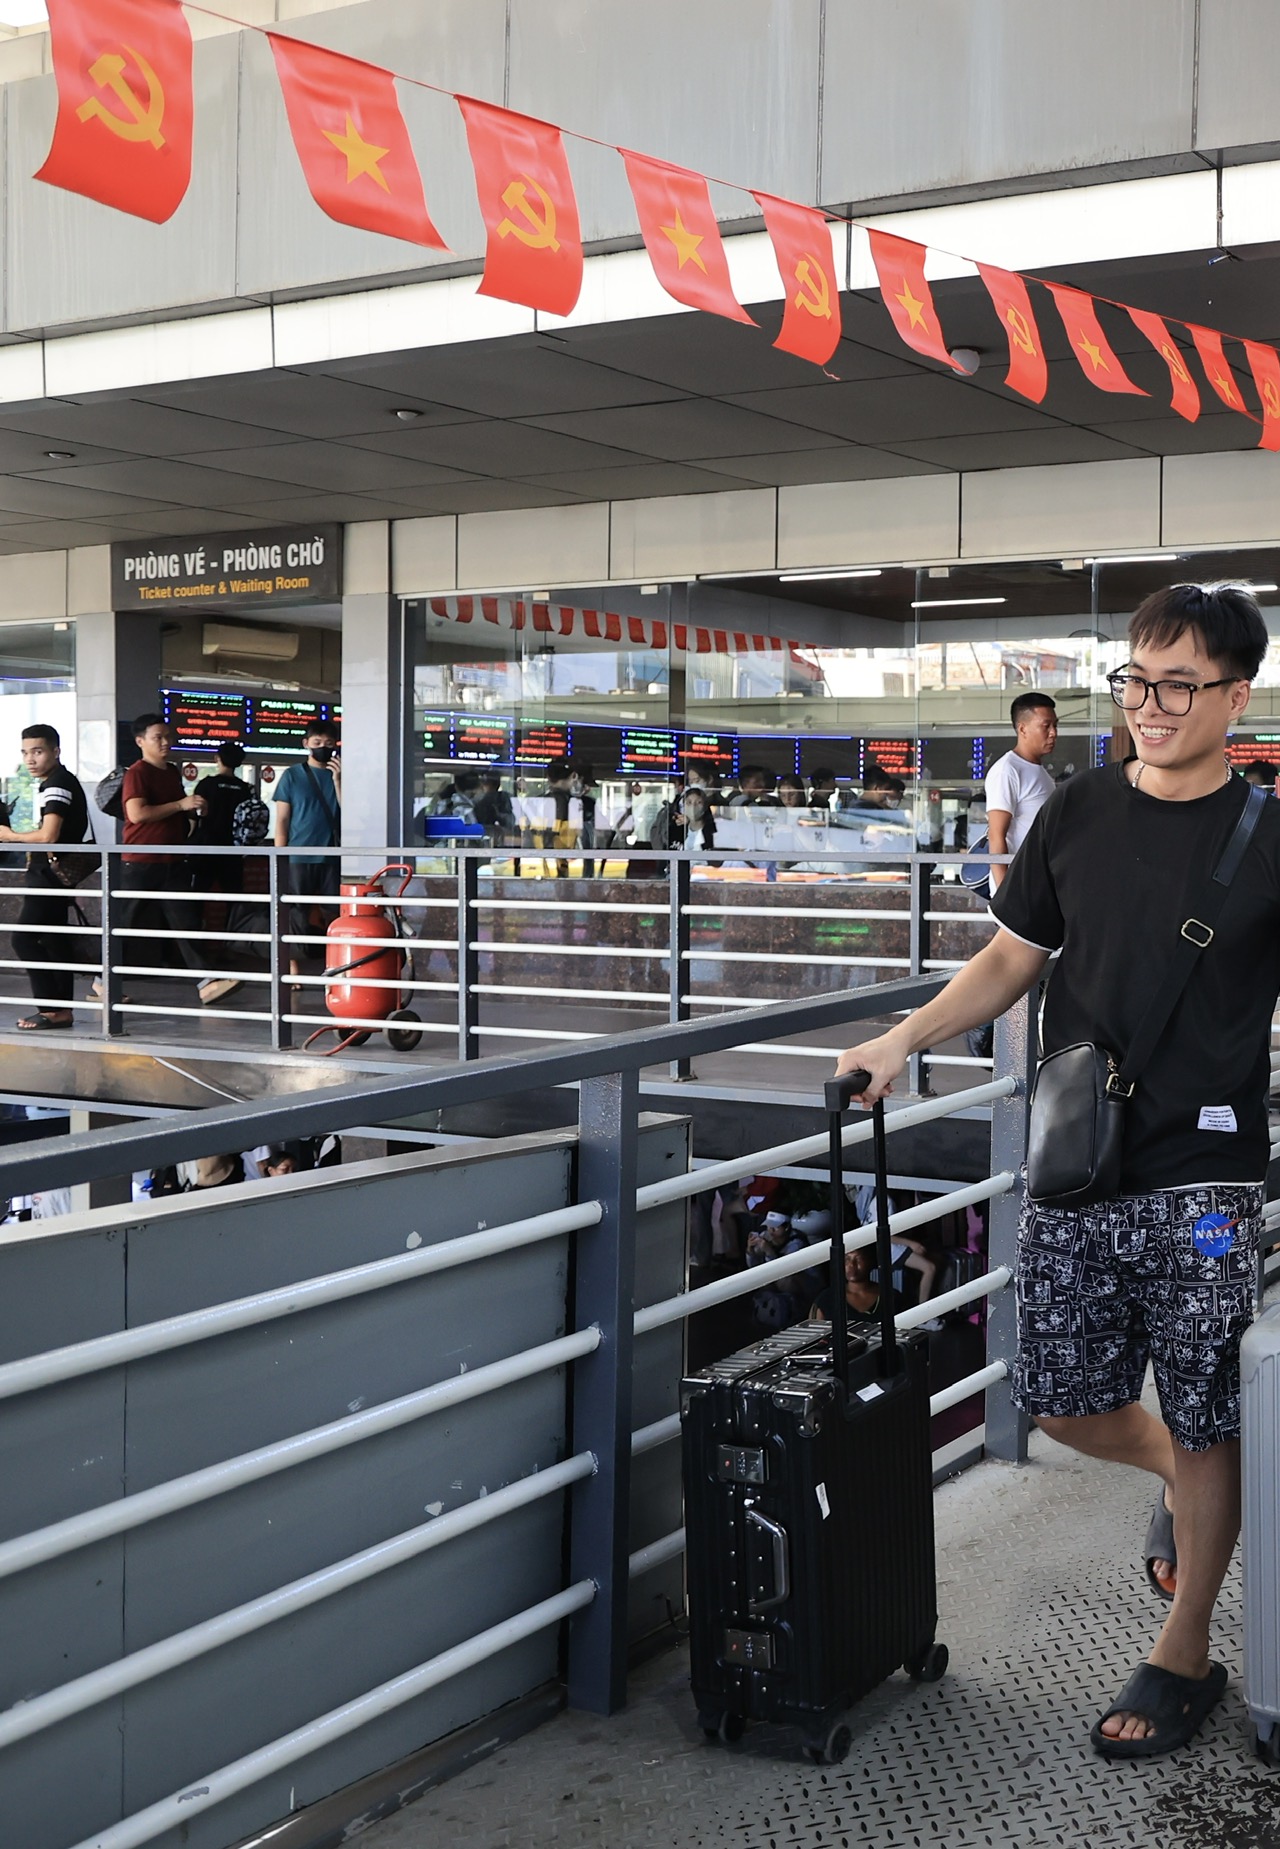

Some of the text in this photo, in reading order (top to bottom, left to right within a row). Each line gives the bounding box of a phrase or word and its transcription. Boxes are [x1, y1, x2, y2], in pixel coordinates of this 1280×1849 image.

[124, 551, 180, 581] PHÒNG
[183, 546, 206, 576] VÉ
[223, 542, 282, 572] PHÒNG
[286, 536, 325, 567] CHỜ
[138, 576, 309, 600] Ticket counter & Waiting Room
[184, 767, 197, 777] 03
[1195, 1228, 1231, 1240] NASA
